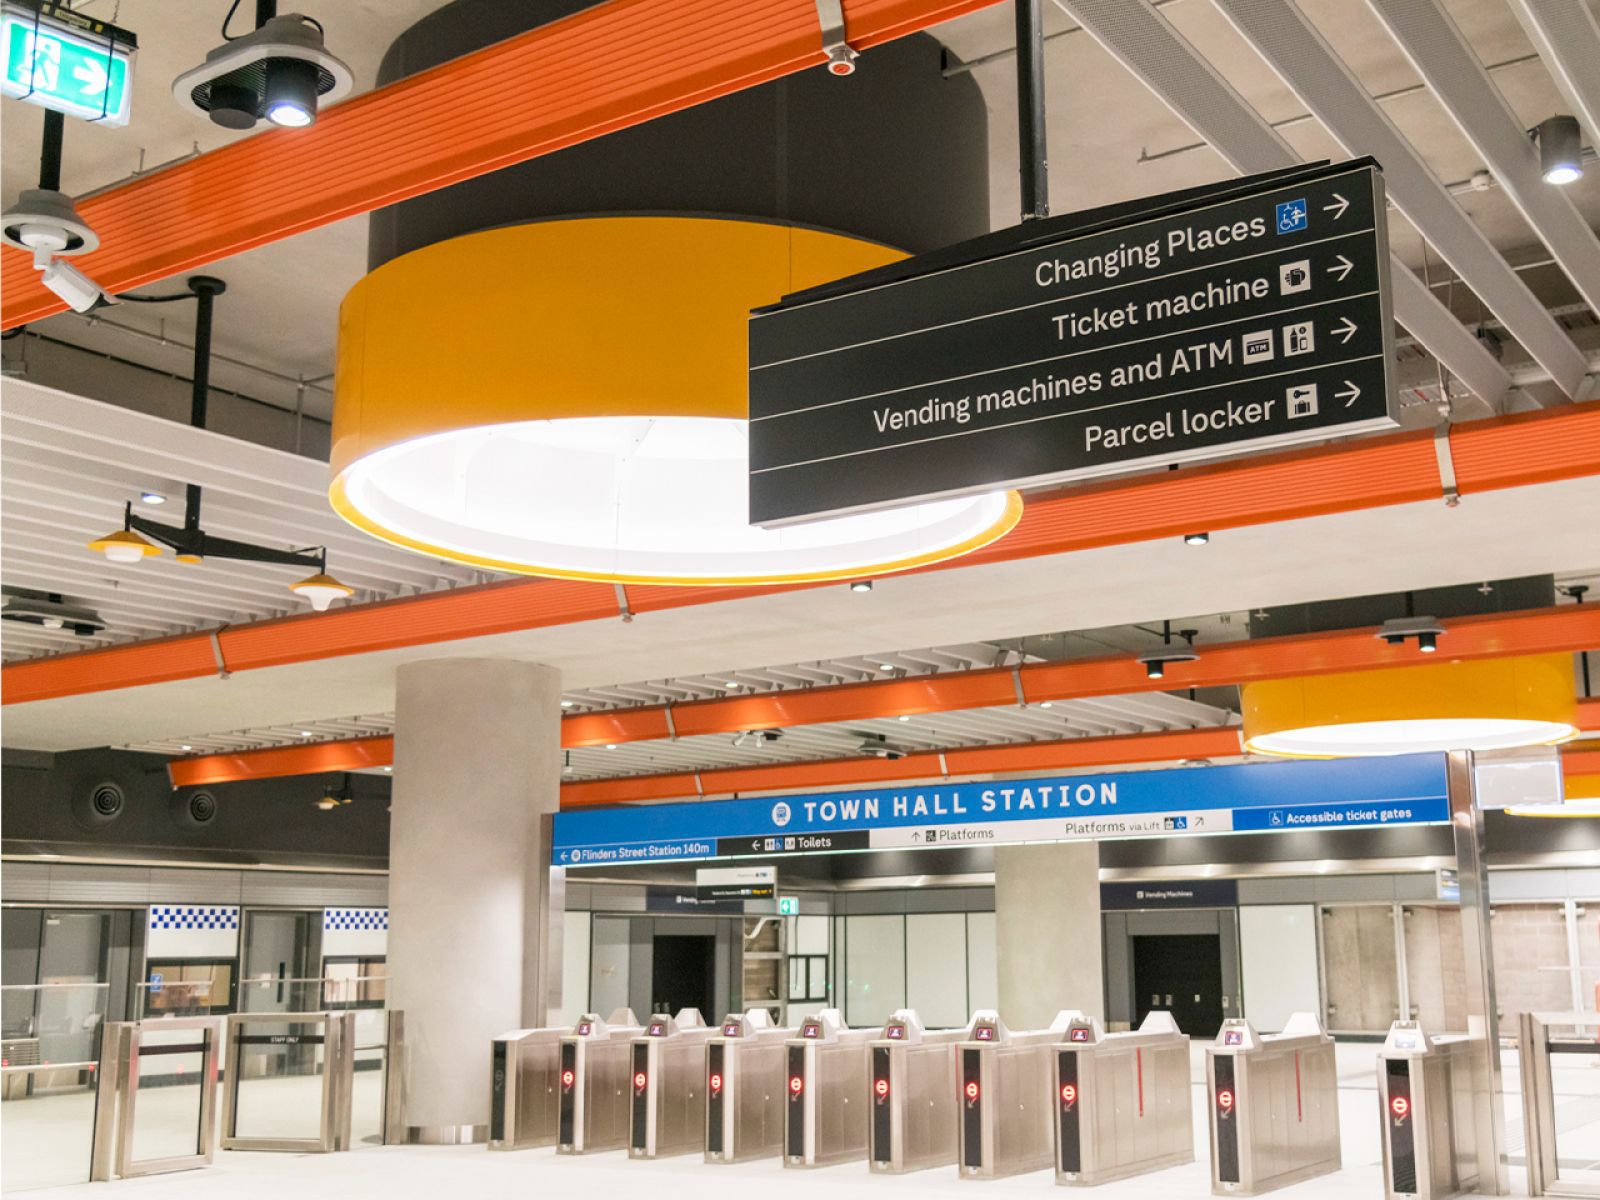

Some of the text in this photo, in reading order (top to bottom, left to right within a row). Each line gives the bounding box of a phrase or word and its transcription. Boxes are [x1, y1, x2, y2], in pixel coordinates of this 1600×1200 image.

[1035, 215, 1266, 288] Changing Places
[1052, 274, 1269, 340] Ticket machine
[1249, 344, 1267, 354] ATM
[873, 339, 1233, 433] Vending machines and ATM
[1084, 397, 1276, 452] Parcel locker
[804, 782, 1118, 823] TOWN HALL STATION
[1286, 808, 1412, 825] Accessible ticket gates
[939, 828, 994, 841] Platforms
[1065, 821, 1160, 834] Platforms via Lift
[798, 836, 832, 848] Toilets
[581, 843, 709, 860] Flinders Street Station 140m
